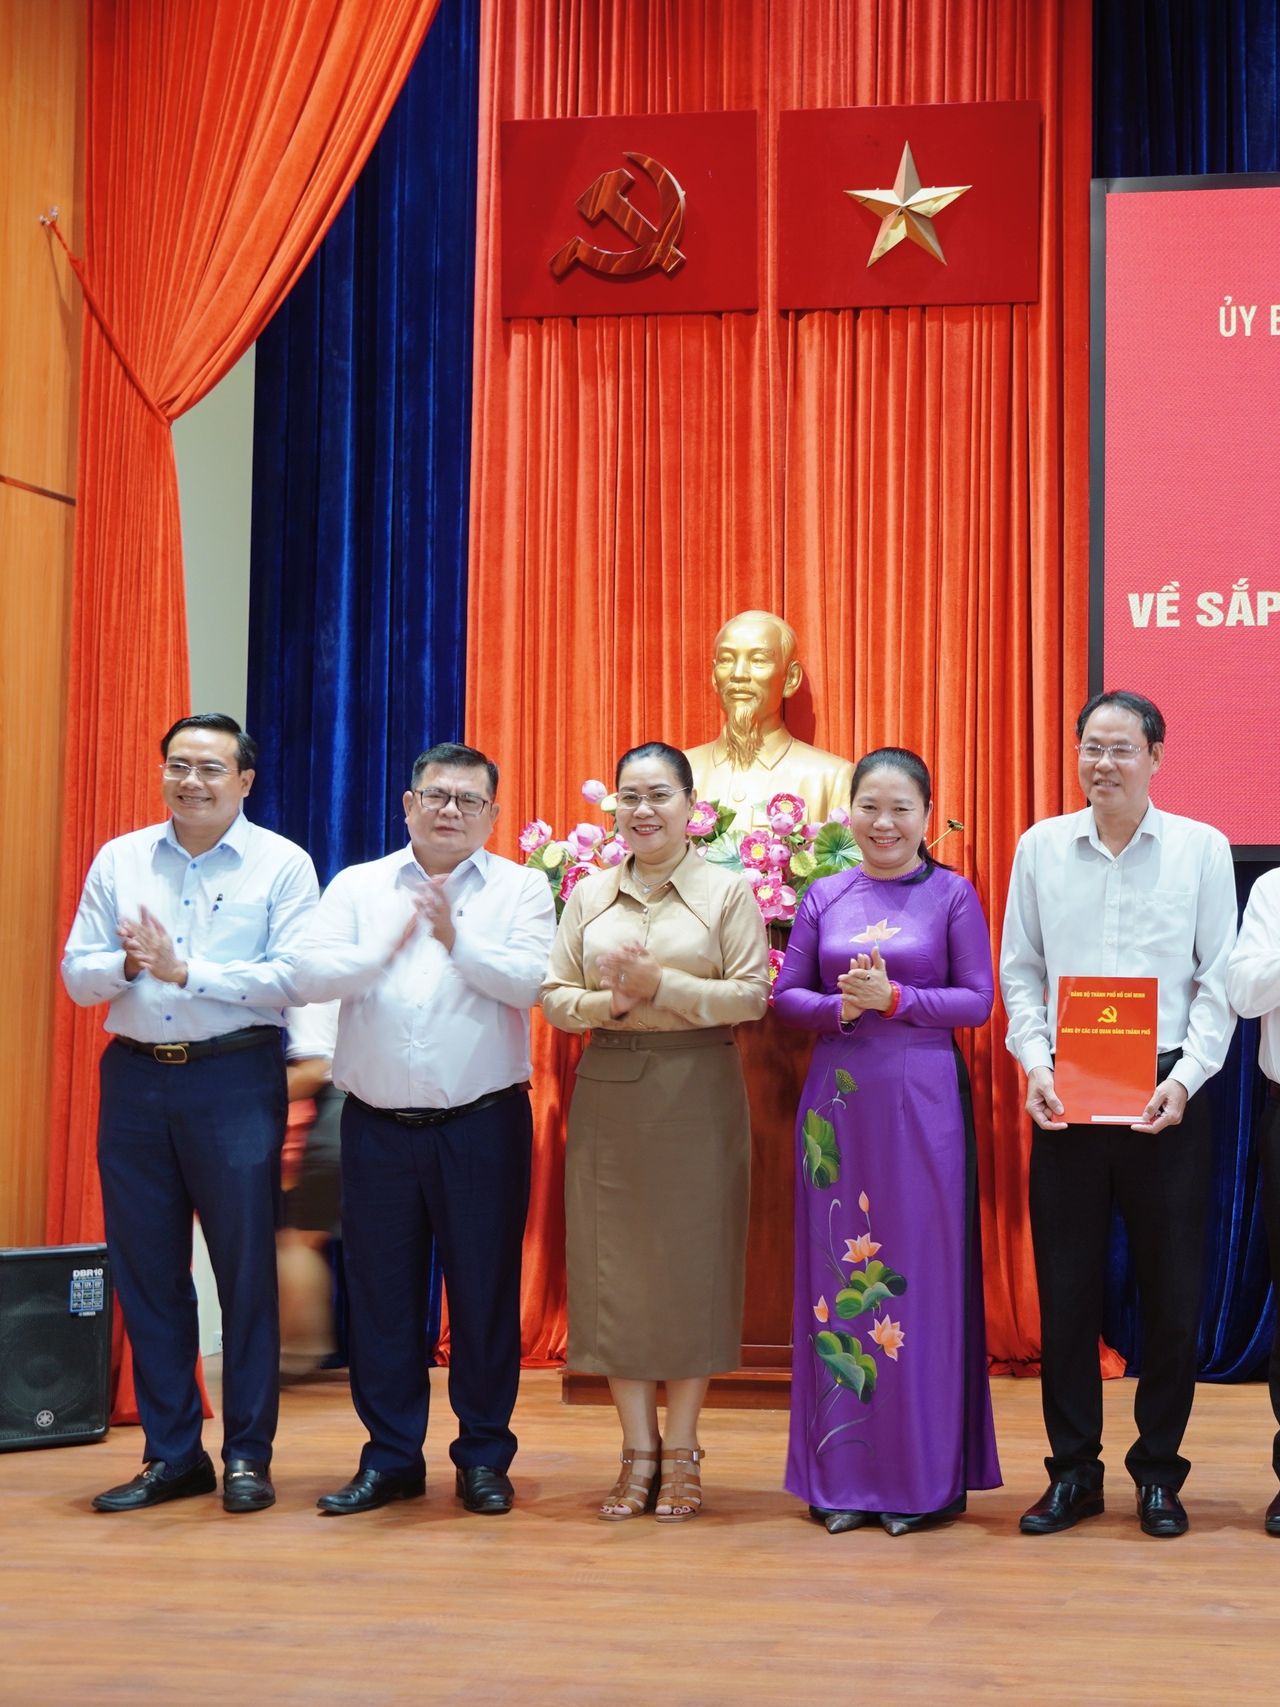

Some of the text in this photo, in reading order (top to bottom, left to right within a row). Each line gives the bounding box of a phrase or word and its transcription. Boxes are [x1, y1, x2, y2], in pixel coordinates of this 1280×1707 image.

[1219, 295, 1258, 338] ỦY
[1127, 580, 1181, 629] VỀ
[73, 1268, 103, 1277] DBR10
